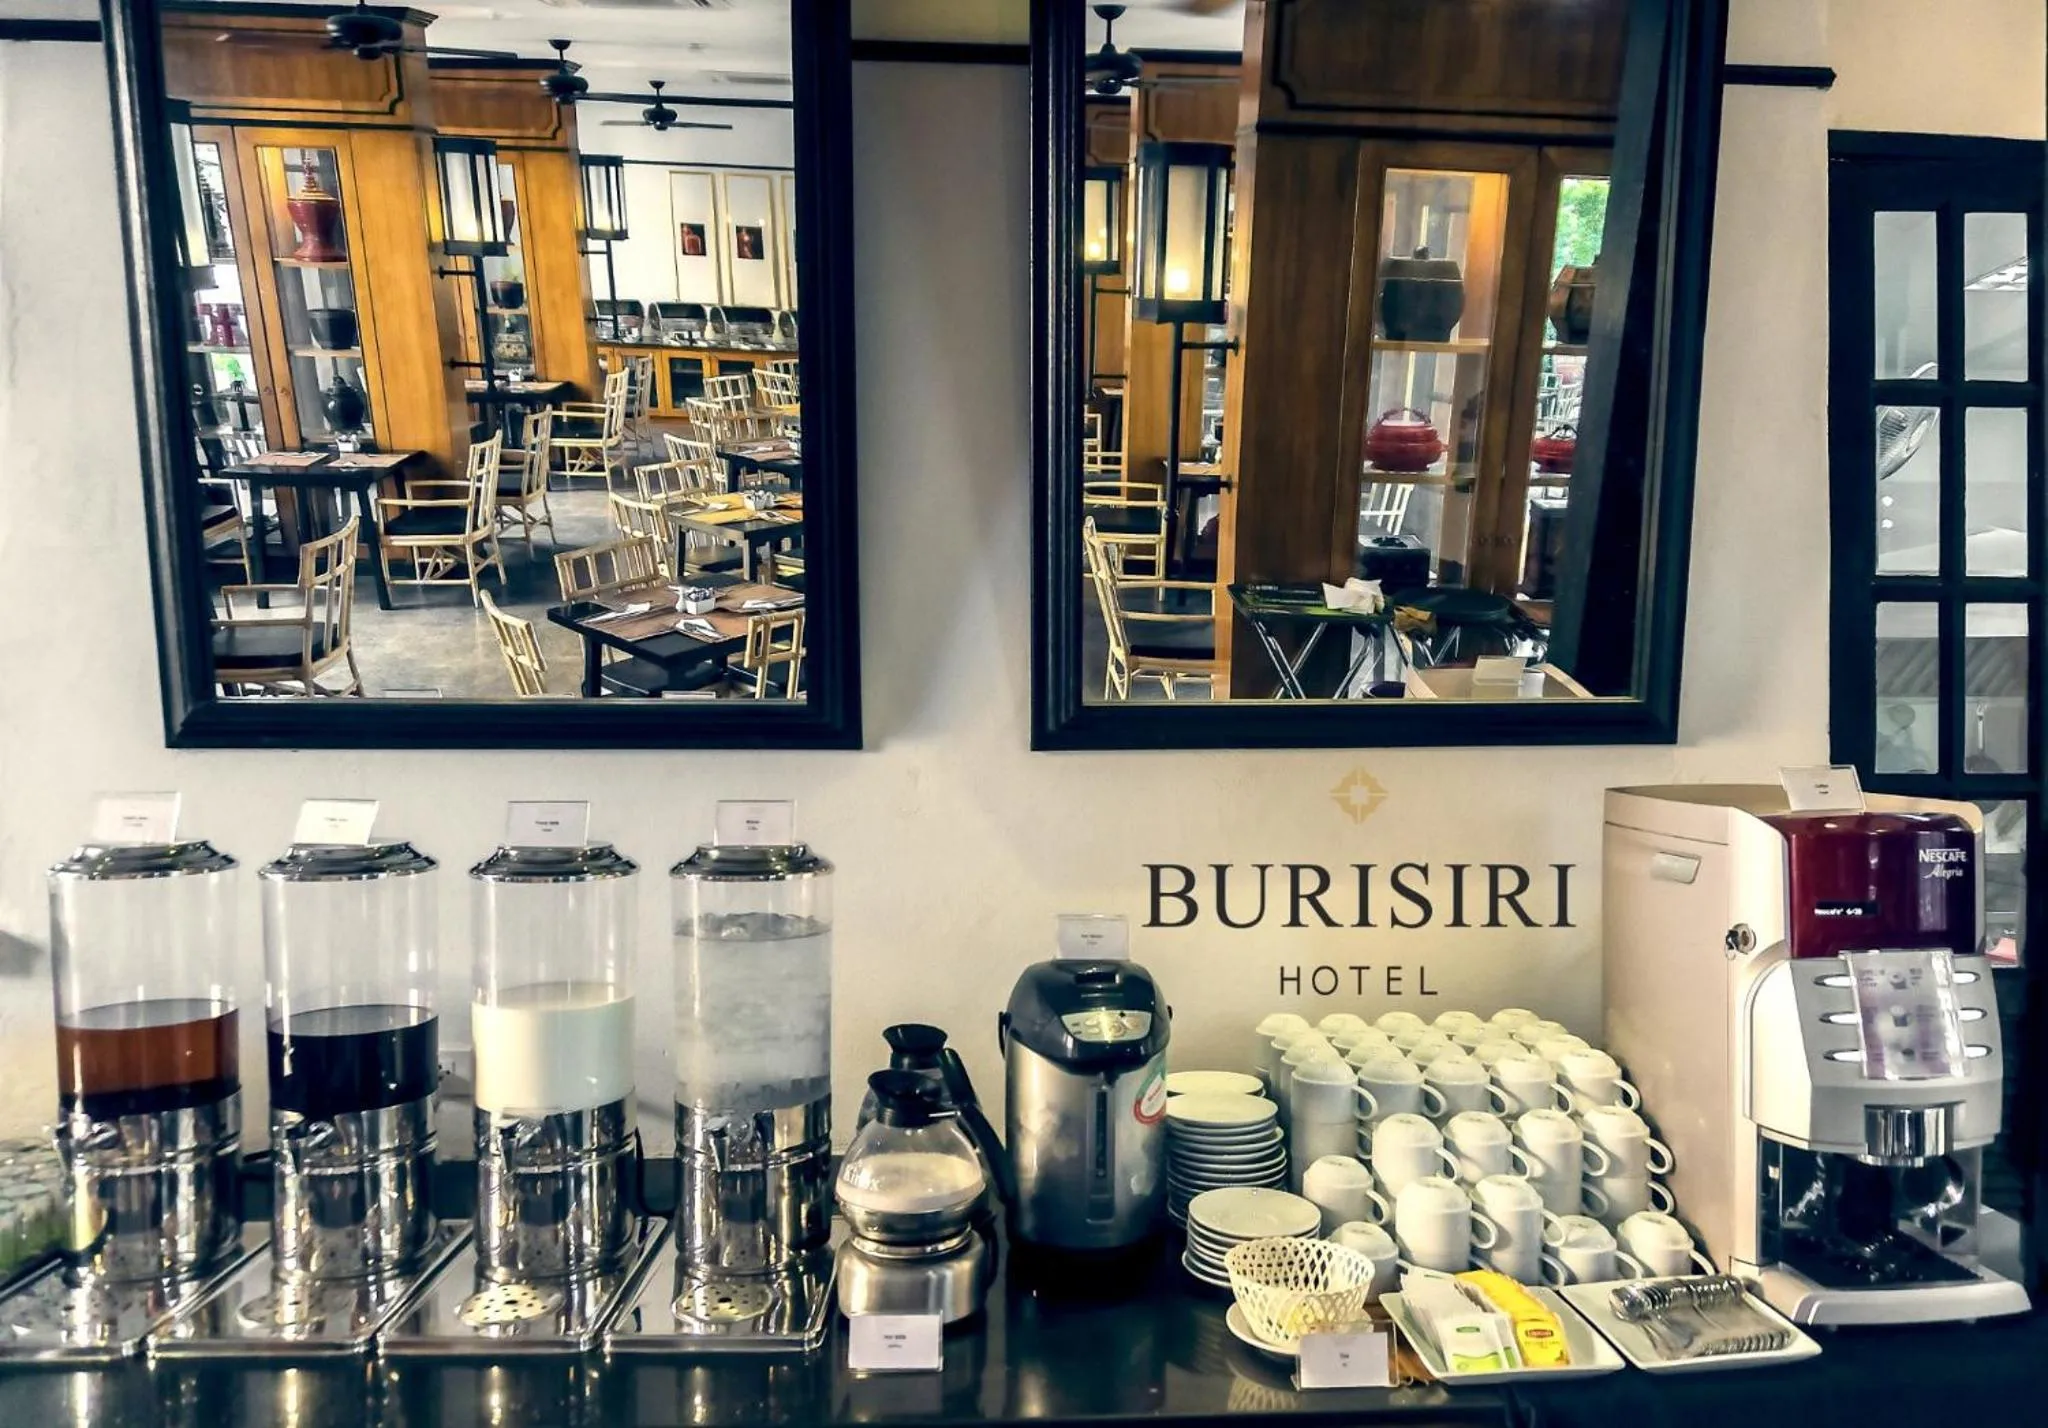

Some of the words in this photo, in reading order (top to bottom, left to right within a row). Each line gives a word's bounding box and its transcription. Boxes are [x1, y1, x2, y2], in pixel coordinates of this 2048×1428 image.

[1921, 863, 1964, 880] Alegria
[1142, 862, 1576, 929] BURISIRI
[1280, 965, 1438, 996] HOTEL
